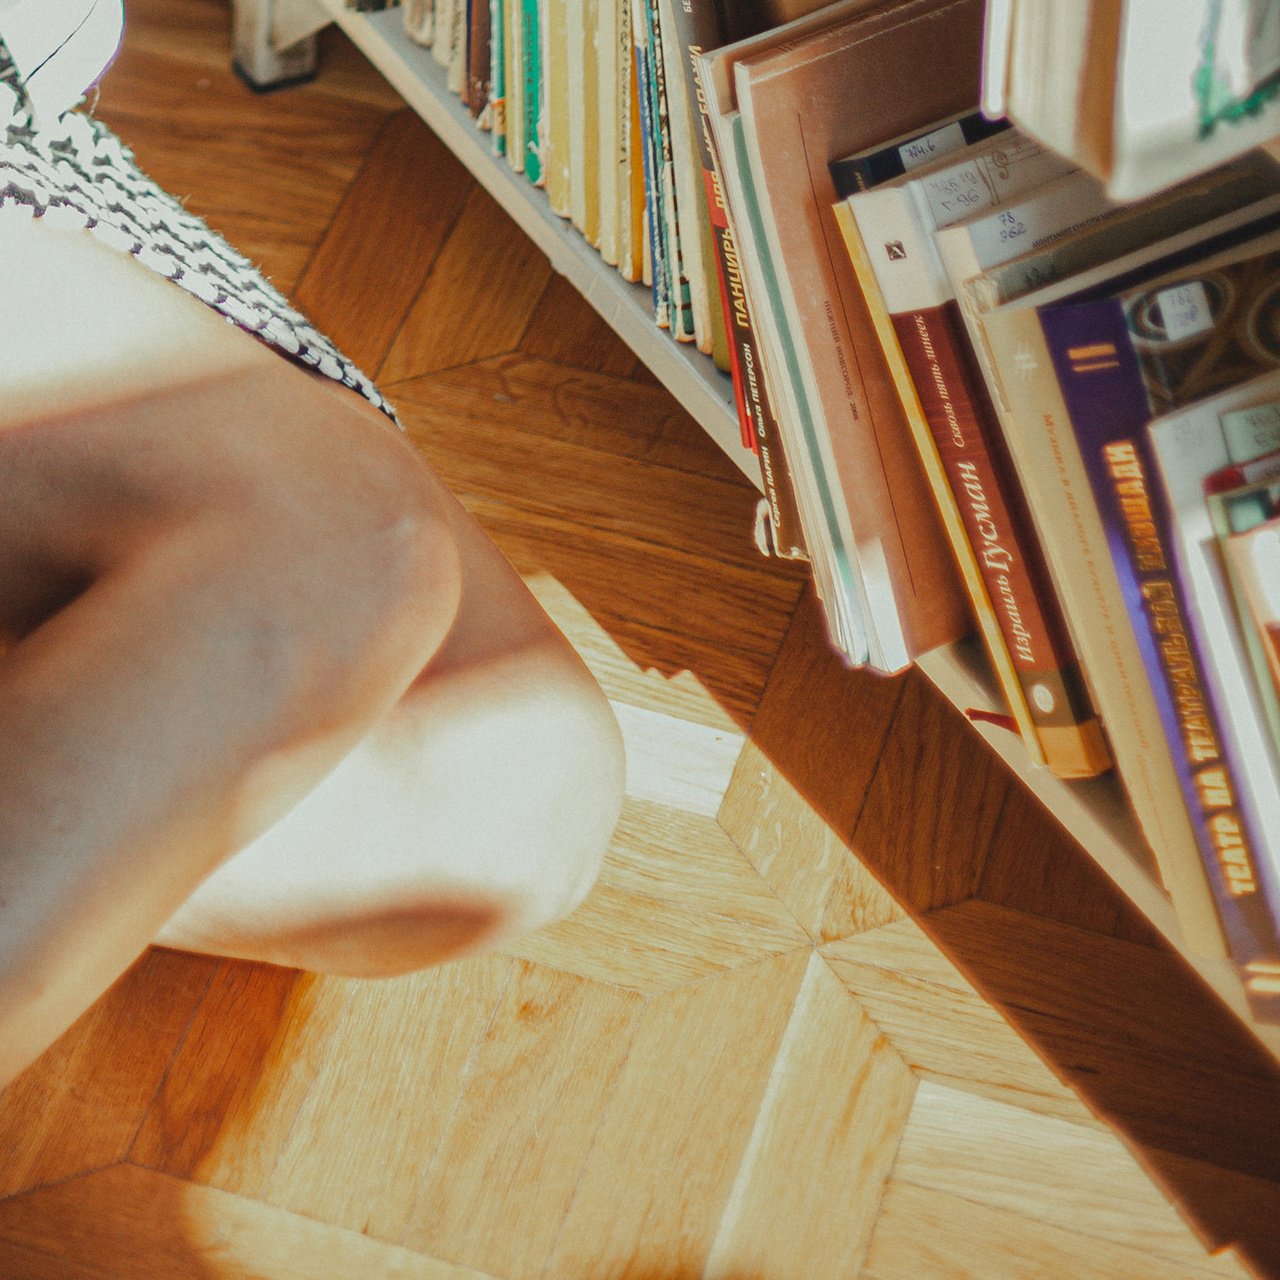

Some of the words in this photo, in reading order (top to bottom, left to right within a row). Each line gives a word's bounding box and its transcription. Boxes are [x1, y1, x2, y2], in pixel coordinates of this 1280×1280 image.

[721, 226, 750, 328] ПАНЦИРЬ
[912, 313, 937, 364] линеек
[742, 341, 760, 403] ПЕТЕРСОН
[928, 363, 950, 401] пять
[753, 404, 766, 437] Ольга
[940, 401, 965, 449] Сквозь
[759, 444, 775, 487] ПАРИН
[767, 487, 782, 527] Сергей
[954, 455, 1014, 576] Гусман
[1102, 436, 1168, 575] ПЛОЩАДИ
[992, 572, 1036, 664] Израиль
[1140, 575, 1219, 765] ТЕАТРАЛЬНОЙ
[1195, 766, 1231, 811] НА
[1207, 810, 1256, 898] ТЕАТР
